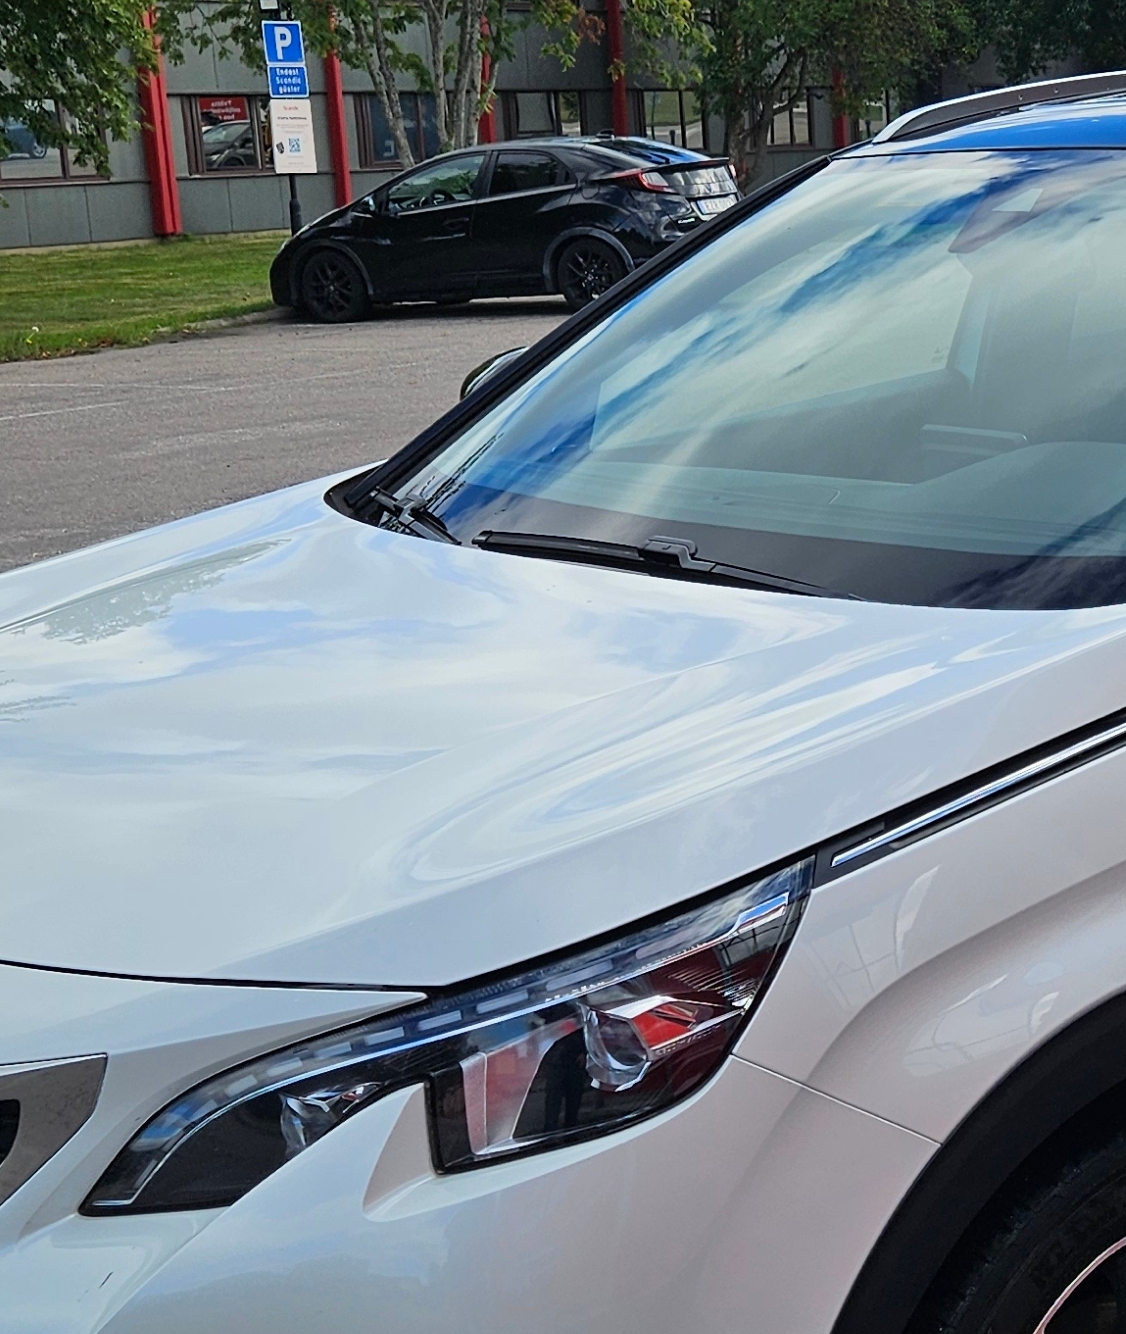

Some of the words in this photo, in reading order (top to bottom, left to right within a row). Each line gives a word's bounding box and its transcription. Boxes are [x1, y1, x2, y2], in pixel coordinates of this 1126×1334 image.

[274, 26, 292, 60] P
[276, 68, 299, 76] Endast
[275, 76, 301, 84] Scandic
